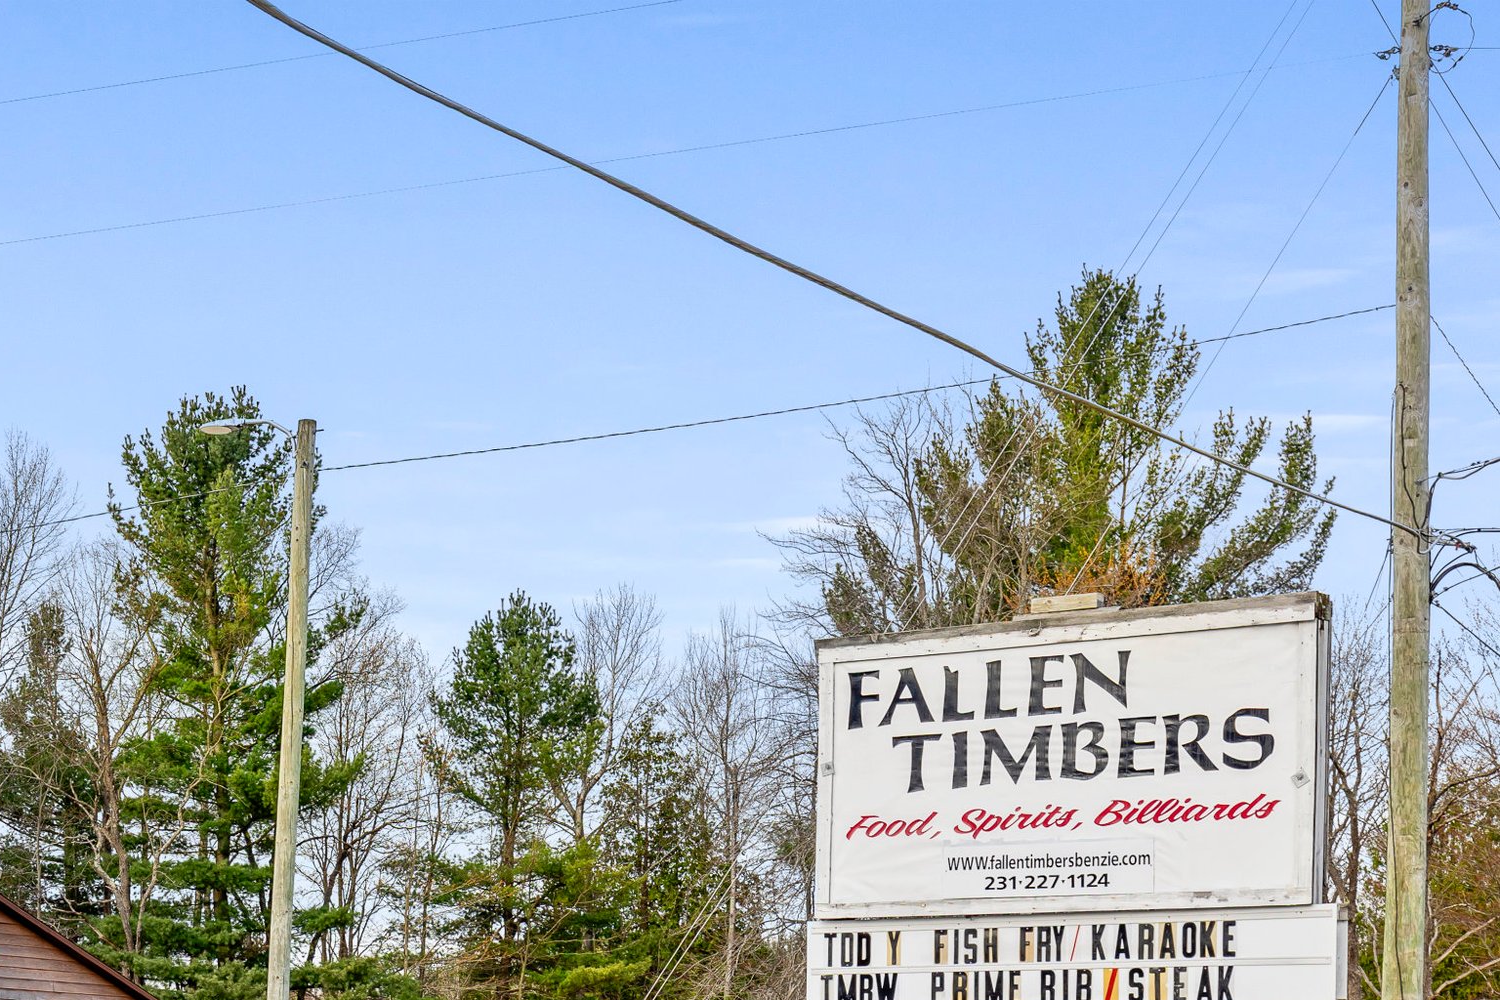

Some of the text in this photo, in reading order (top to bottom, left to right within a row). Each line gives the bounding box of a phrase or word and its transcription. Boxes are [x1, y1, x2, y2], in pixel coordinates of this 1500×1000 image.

[848, 650, 1132, 730] FALLEN
[892, 708, 1275, 793] TIMBERS
[846, 793, 1282, 840] Food, Spirits, Billiards
[934, 927, 998, 964] FISH
